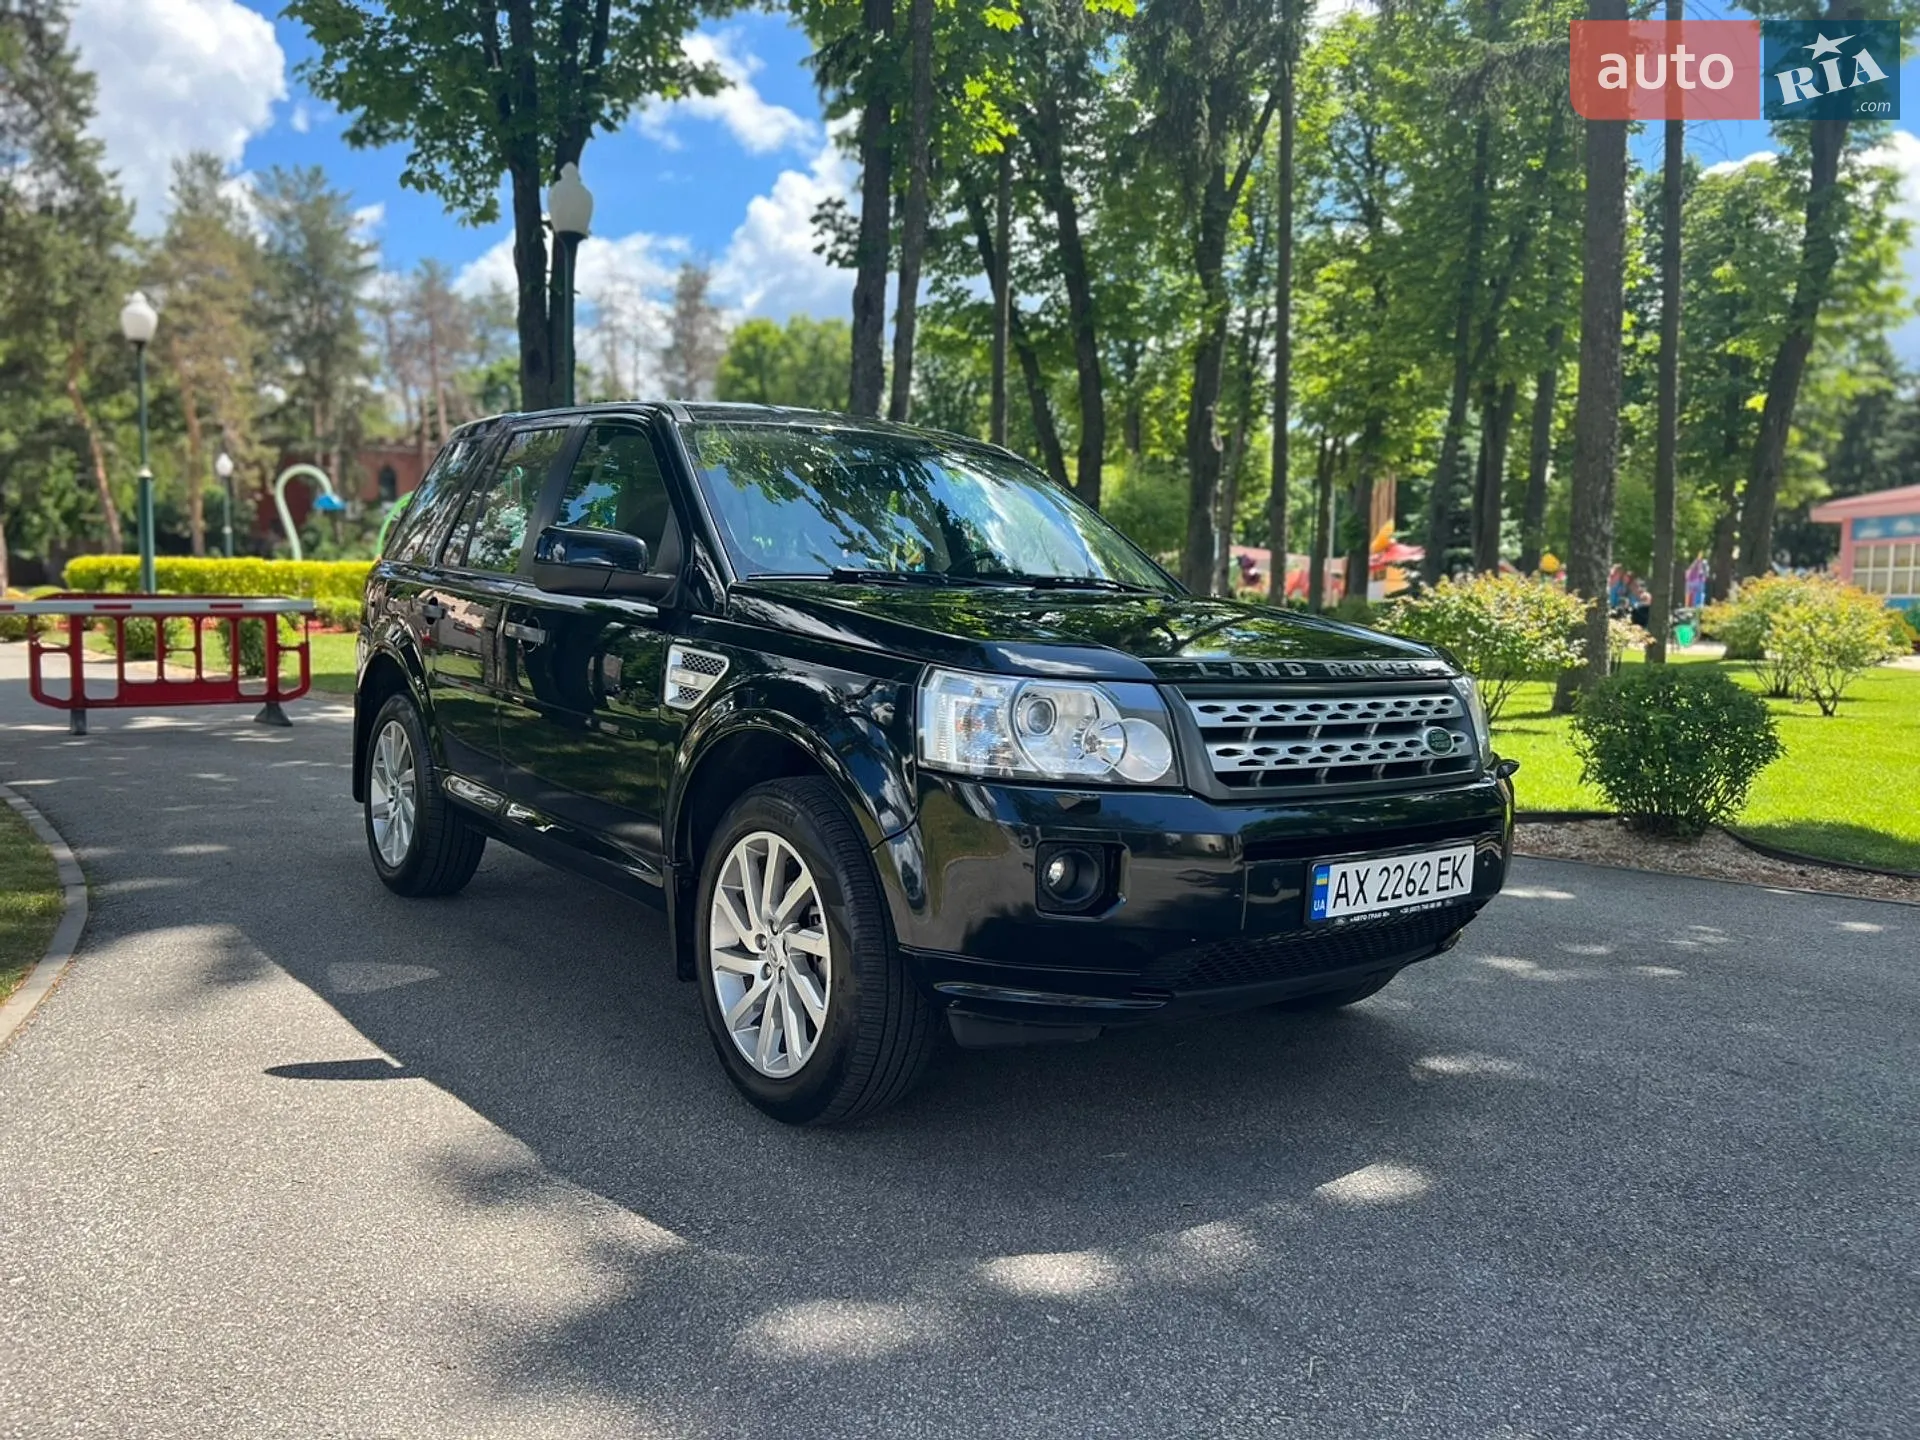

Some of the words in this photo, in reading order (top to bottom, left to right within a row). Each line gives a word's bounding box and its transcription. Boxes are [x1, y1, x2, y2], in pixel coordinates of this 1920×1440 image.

[1198, 661, 1308, 678] LAND
[1325, 660, 1428, 677] ROVER
[1332, 867, 1371, 909] AX
[1376, 860, 1432, 903] 2262
[1436, 853, 1467, 892] EK
[1313, 899, 1326, 912] UA
